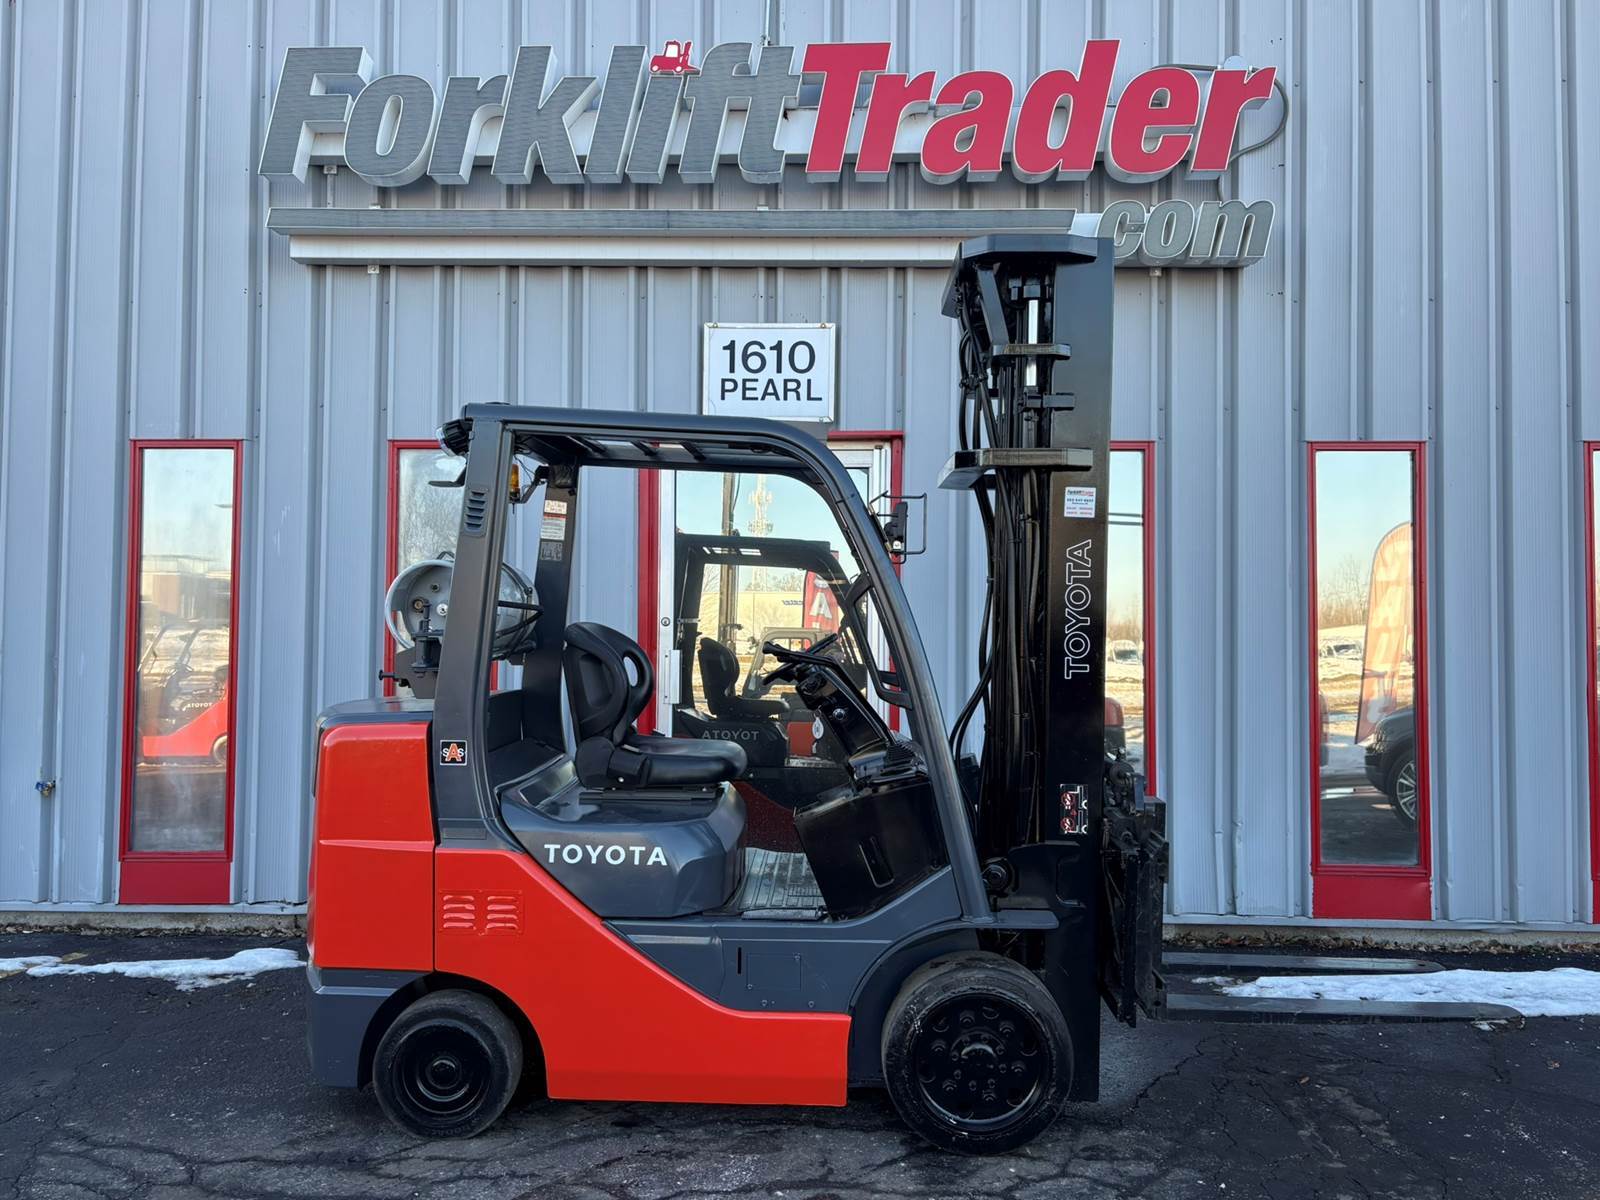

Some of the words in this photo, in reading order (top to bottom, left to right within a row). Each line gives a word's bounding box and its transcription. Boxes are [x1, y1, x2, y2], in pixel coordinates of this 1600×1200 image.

[722, 340, 816, 374] 1610
[720, 378, 823, 401] PEARL
[1064, 539, 1092, 680] TOYOTA
[442, 743, 465, 762] SAS
[543, 843, 668, 866] TOYOTA
